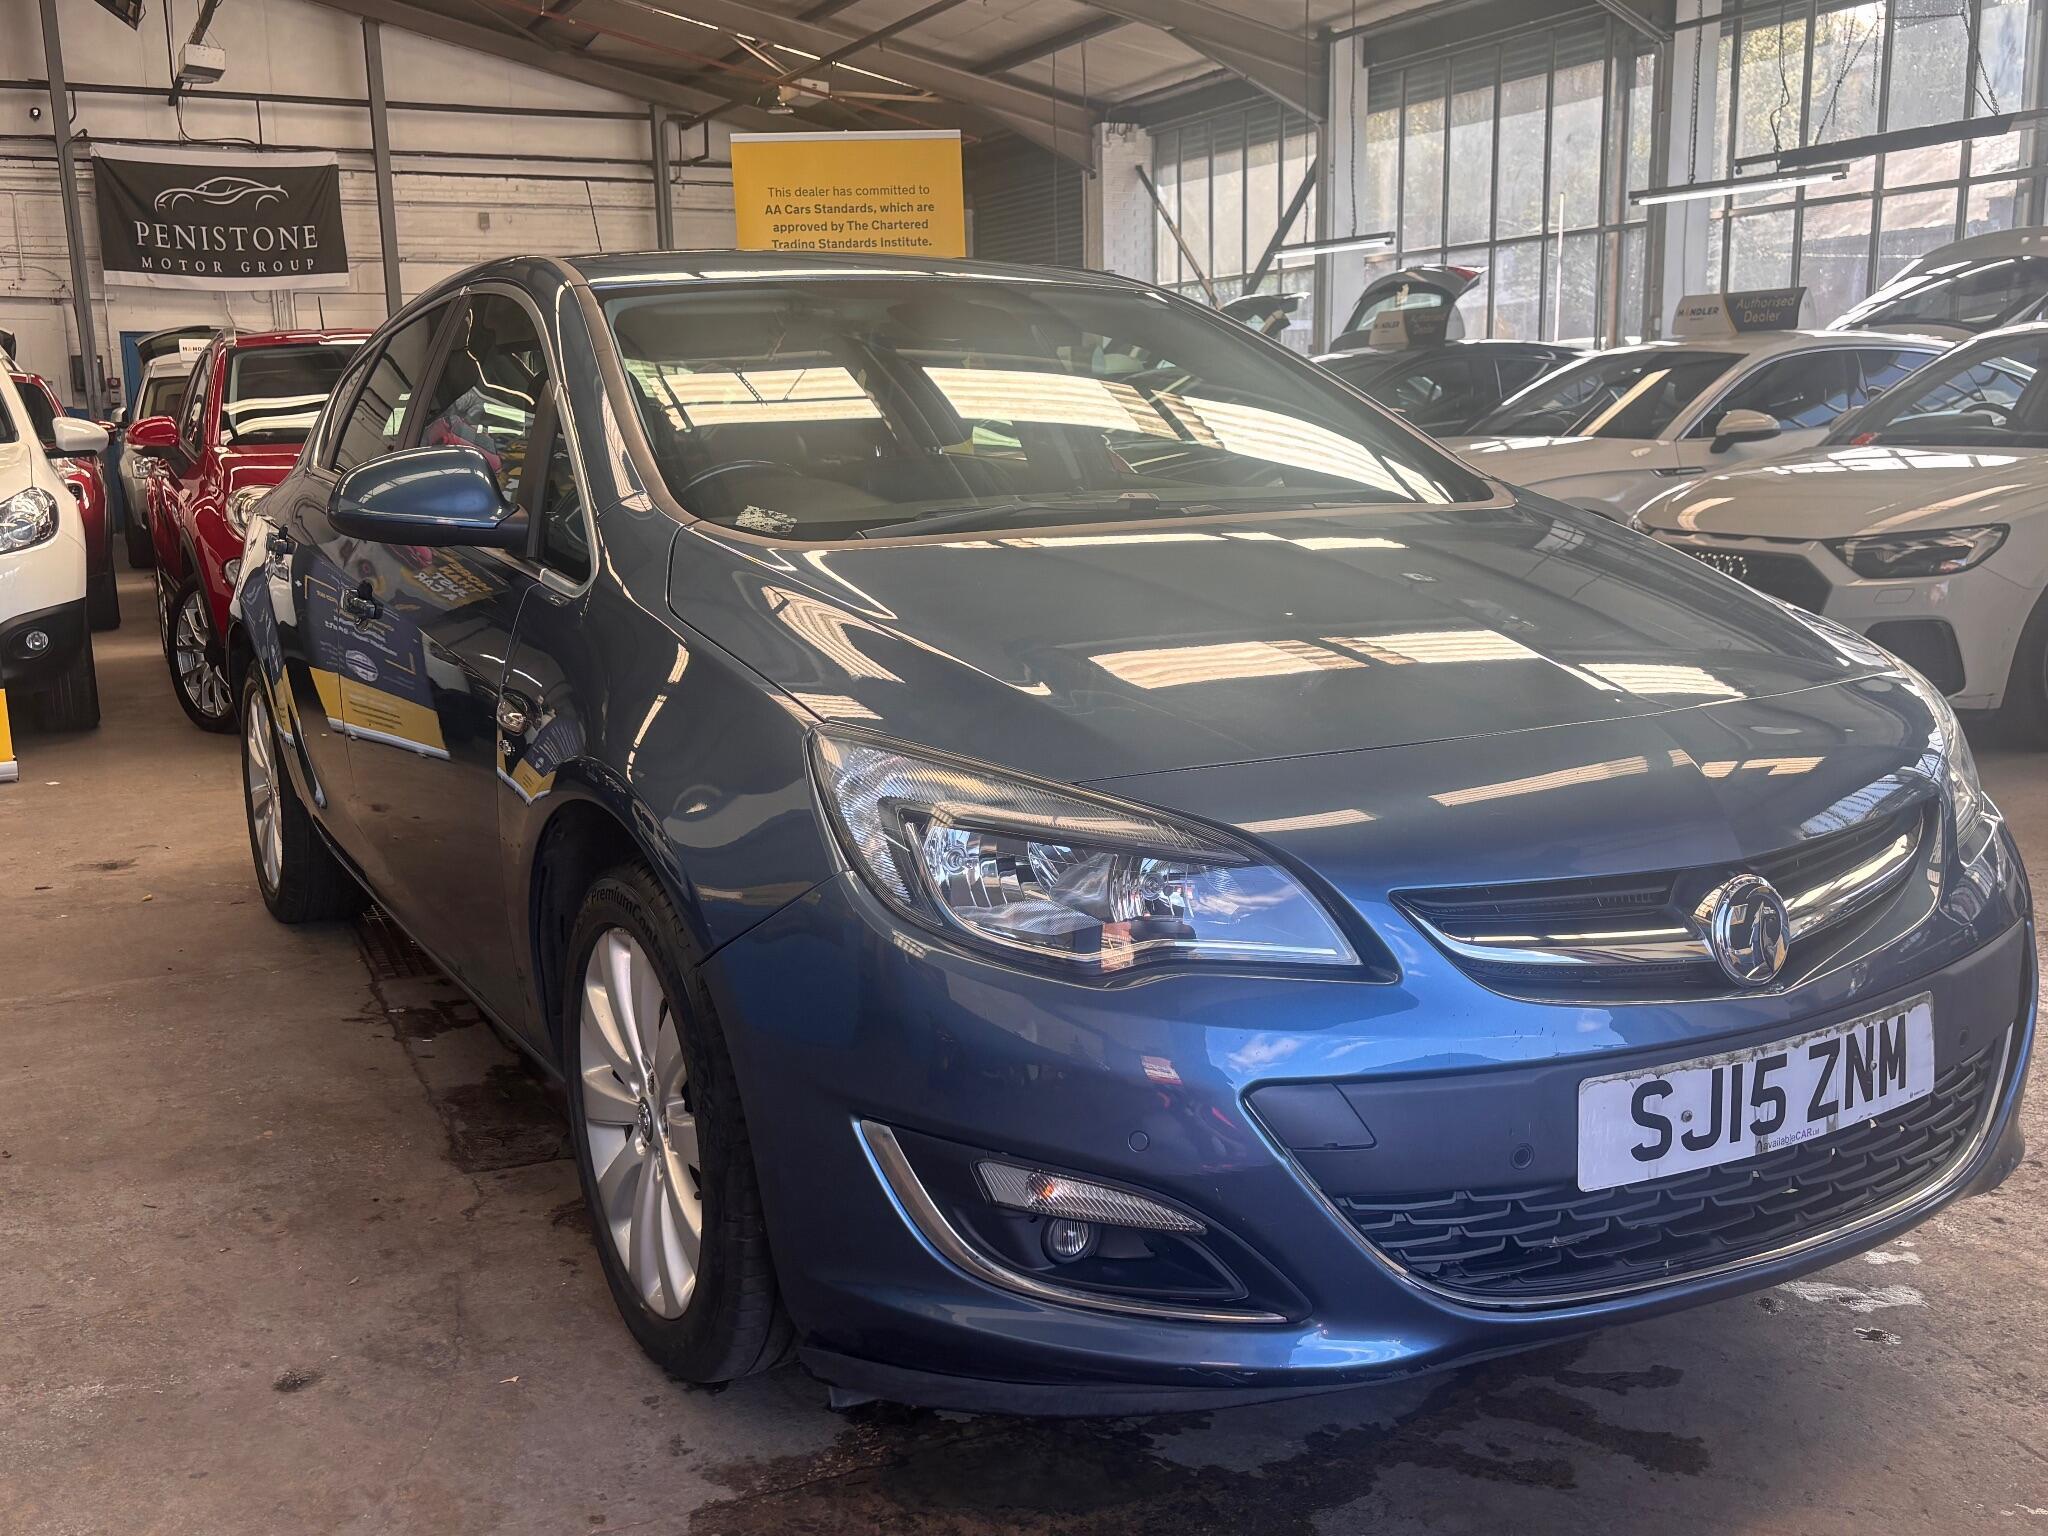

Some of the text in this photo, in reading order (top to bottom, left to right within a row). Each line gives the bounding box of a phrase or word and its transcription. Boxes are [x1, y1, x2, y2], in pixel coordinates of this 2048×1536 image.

[767, 184, 930, 198] This dealer has committed to
[765, 202, 935, 215] AA Cars Standards, which are
[772, 219, 929, 234] approved by The Chartered
[133, 220, 318, 252] PENISTONE
[771, 236, 933, 249] Trading Standards Institute.
[141, 256, 315, 273] MOTOR GROUP
[1735, 296, 1795, 311] Authorised
[1743, 310, 1781, 323] Dealer
[1630, 1014, 1907, 1162] SJ15 ZNM
